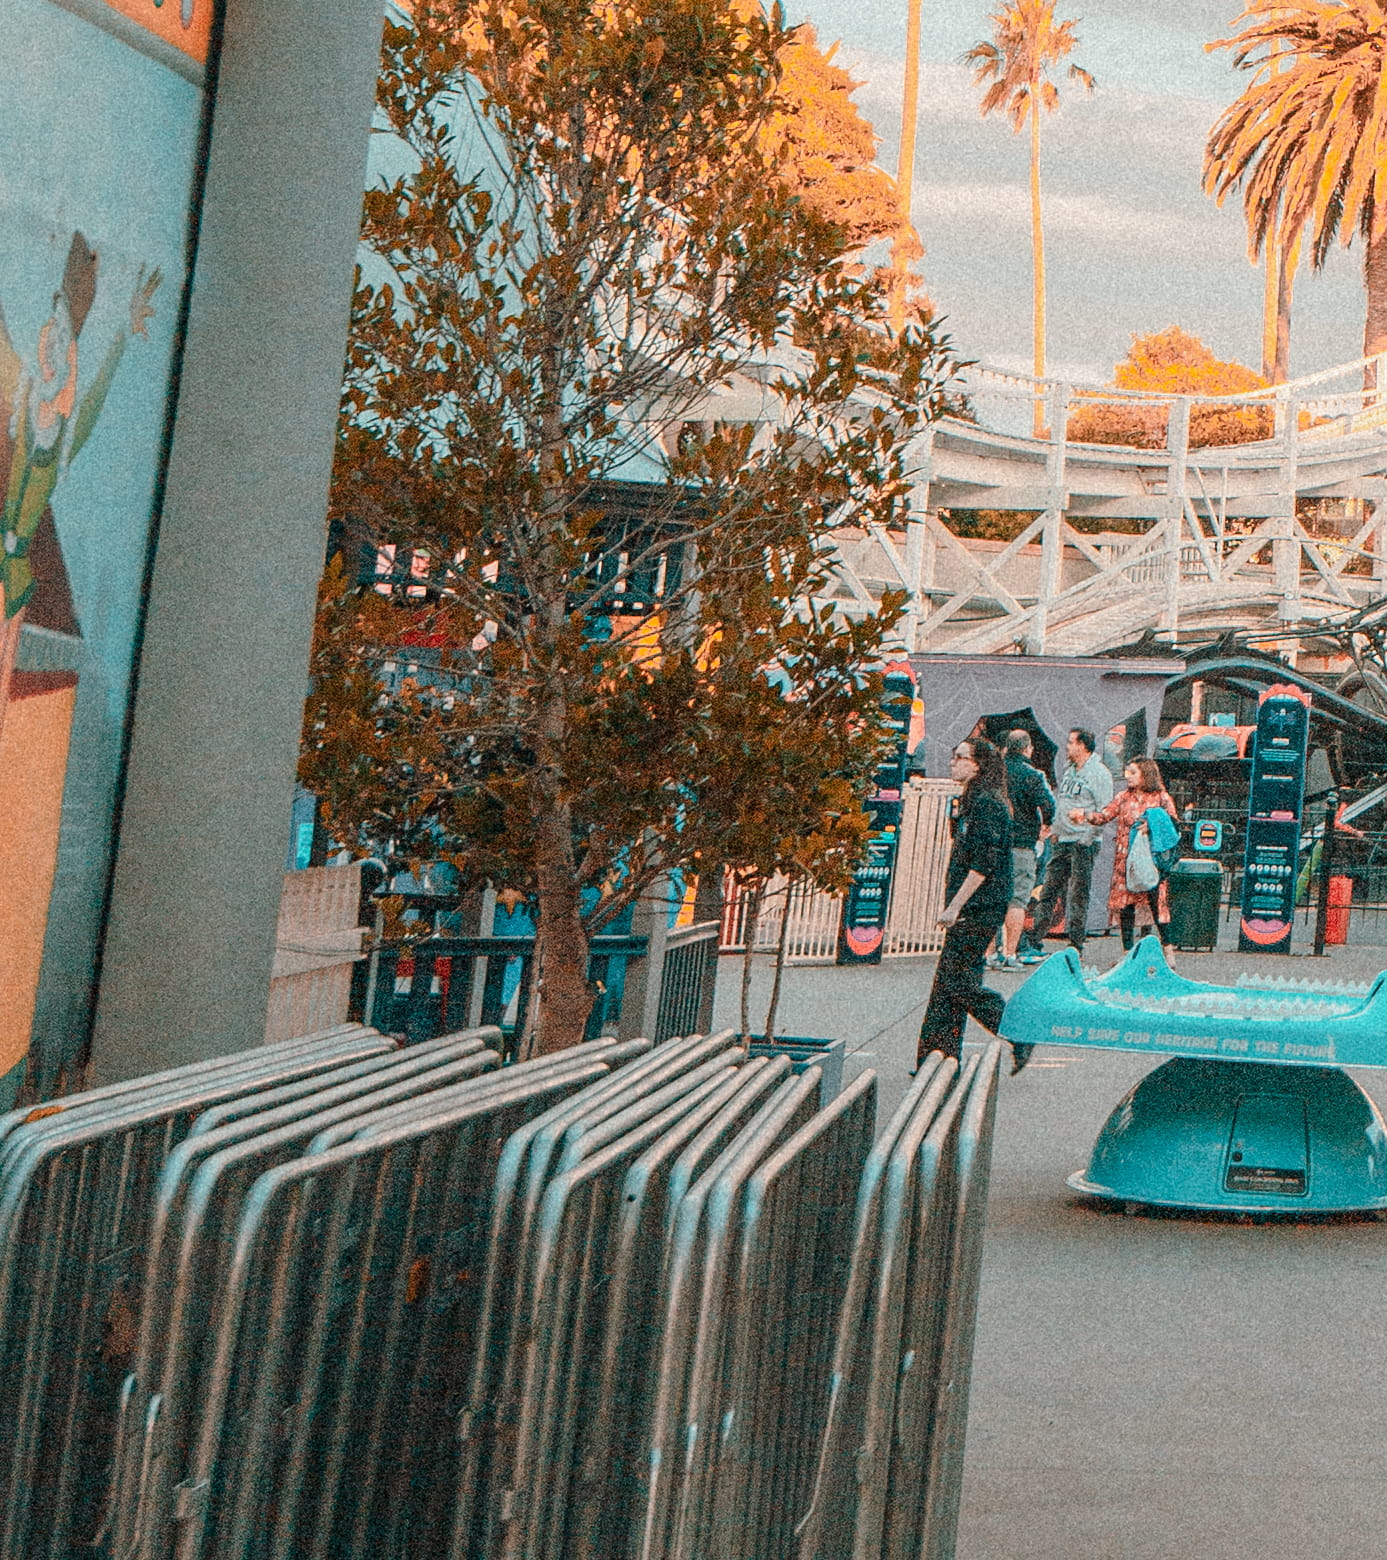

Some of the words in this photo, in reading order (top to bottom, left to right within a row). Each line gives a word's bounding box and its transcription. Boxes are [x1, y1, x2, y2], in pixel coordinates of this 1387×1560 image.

[1087, 1027, 1120, 1042] SAVE
[1124, 1031, 1152, 1044] OUR
[1155, 1033, 1218, 1050] HERITAGE
[1222, 1037, 1249, 1052] FOR
[1255, 1040, 1279, 1054] THE
